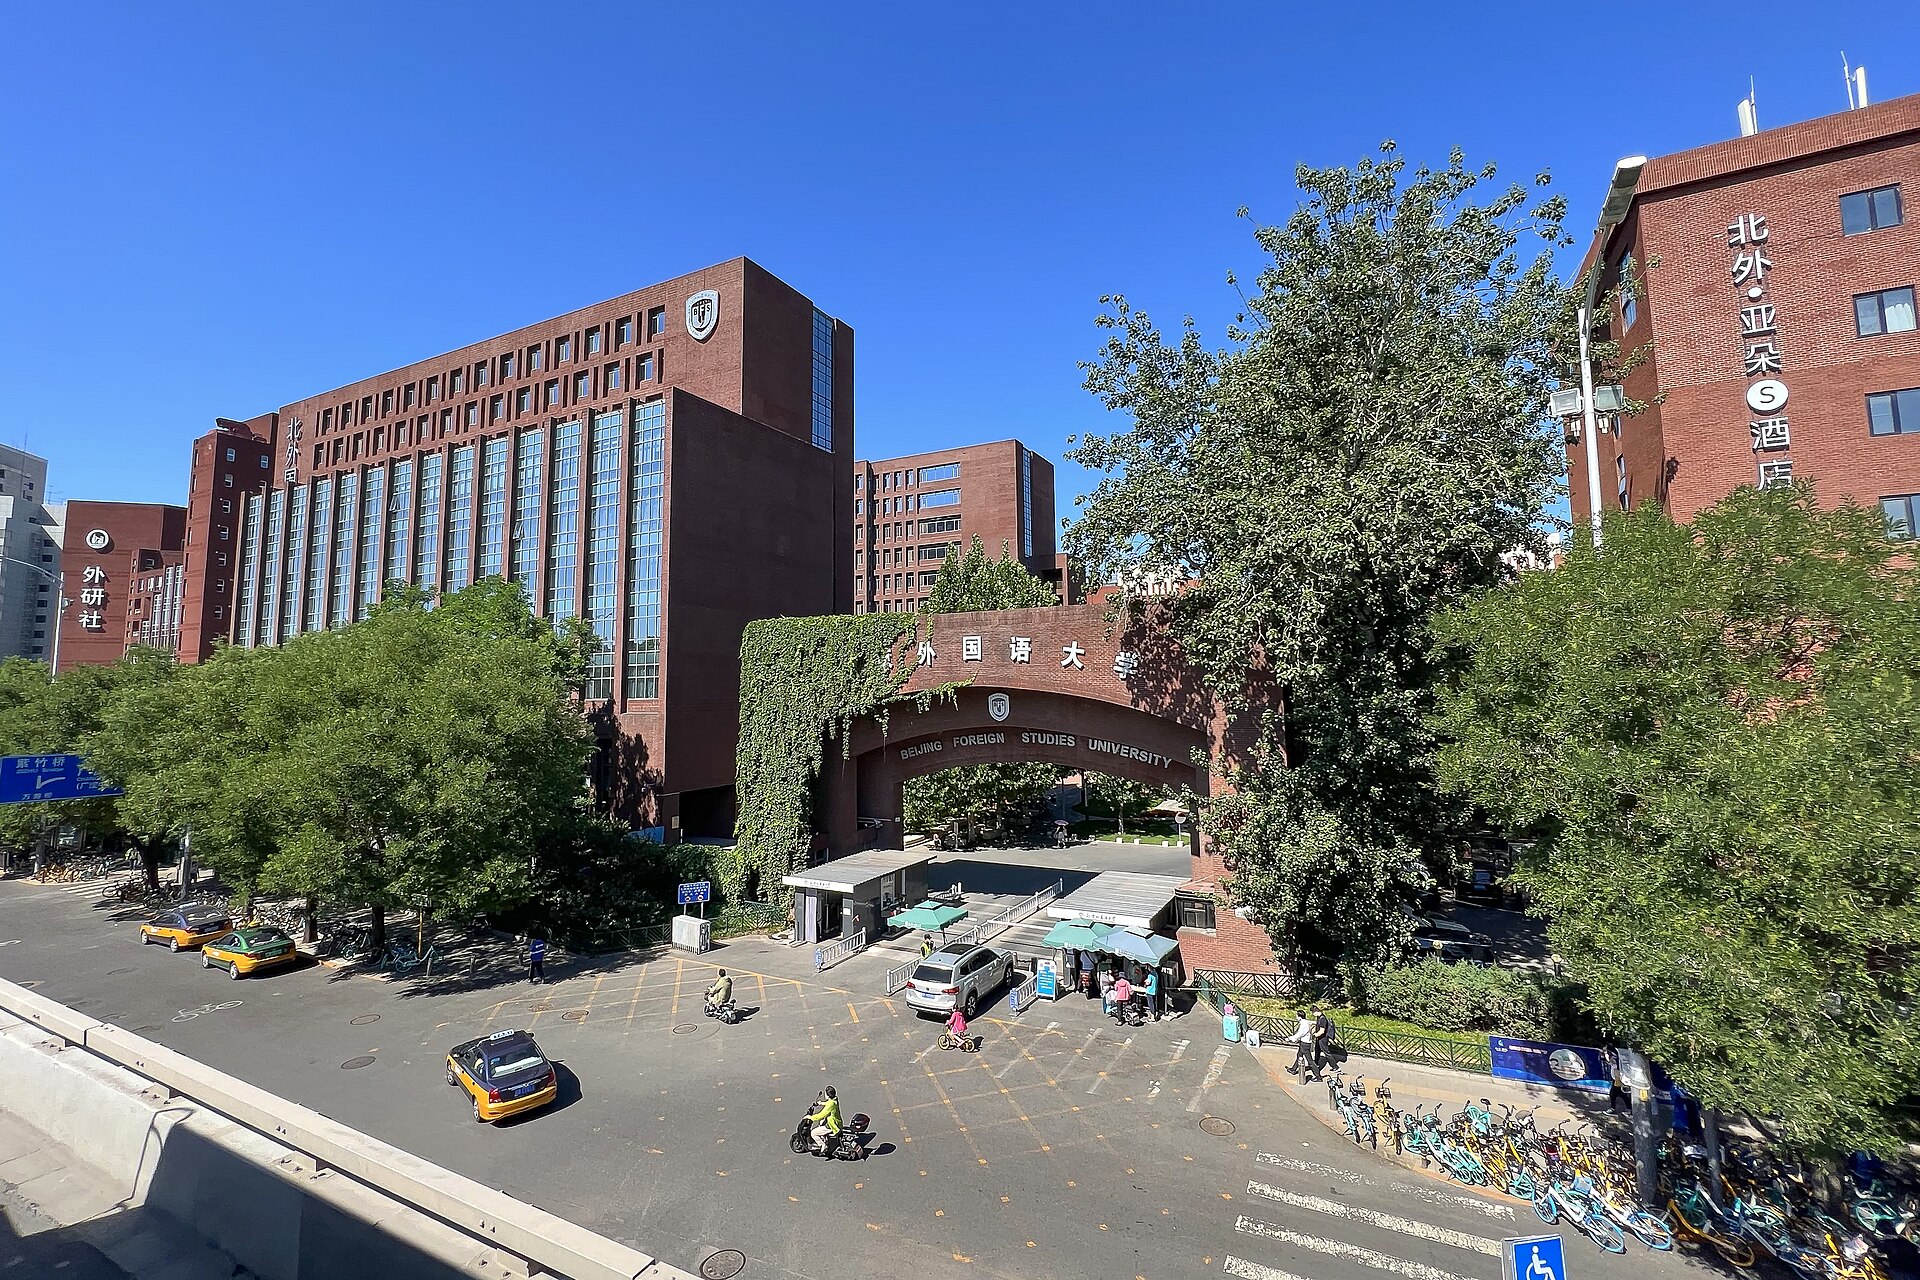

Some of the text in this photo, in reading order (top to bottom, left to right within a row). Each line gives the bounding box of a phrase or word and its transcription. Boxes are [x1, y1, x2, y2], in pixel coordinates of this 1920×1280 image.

[79, 565, 106, 629] 外研社
[885, 635, 1139, 679] 外国语大学
[900, 732, 1172, 769] BEIJING FOREIGN STUDIES UNIVERSITY
